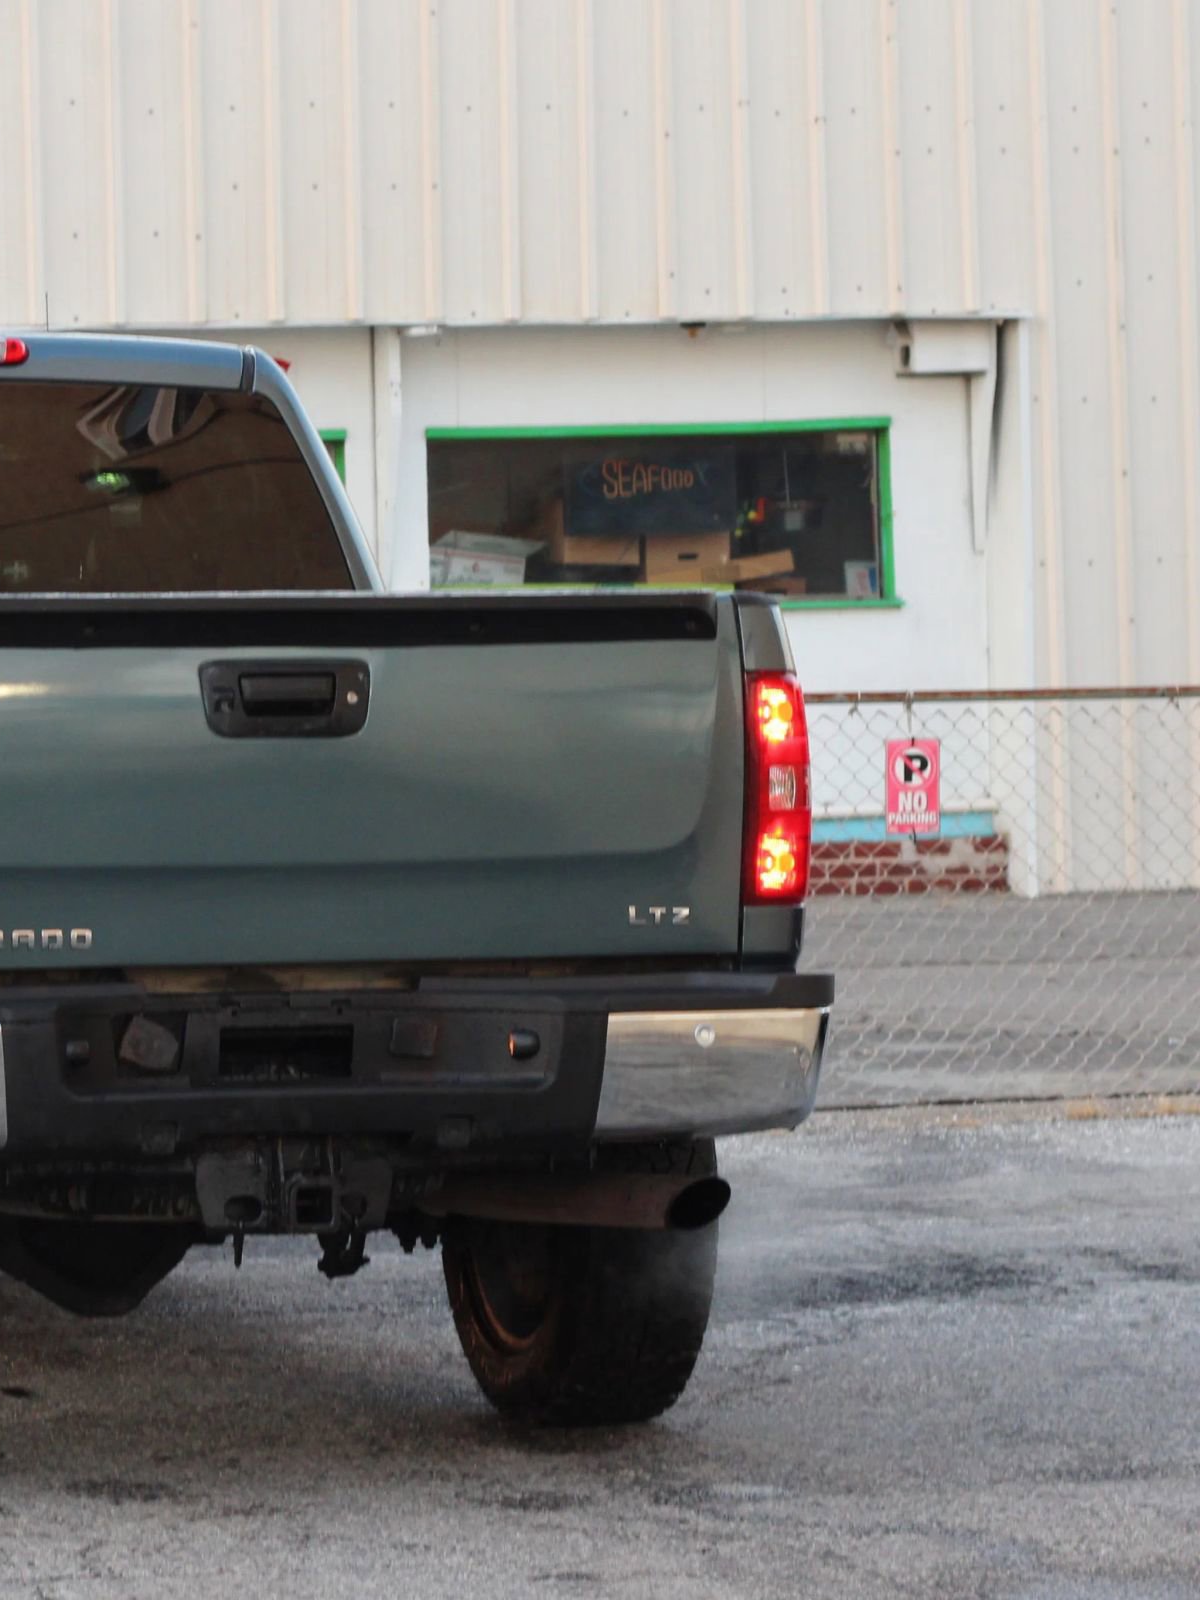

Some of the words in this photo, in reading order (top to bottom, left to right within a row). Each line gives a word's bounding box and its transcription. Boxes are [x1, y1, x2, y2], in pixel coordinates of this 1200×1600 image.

[602, 458, 694, 498] SEAFOOD
[904, 754, 928, 782] P
[898, 791, 928, 813] NO
[888, 811, 937, 825] PARKING
[628, 905, 690, 925] LTZ
